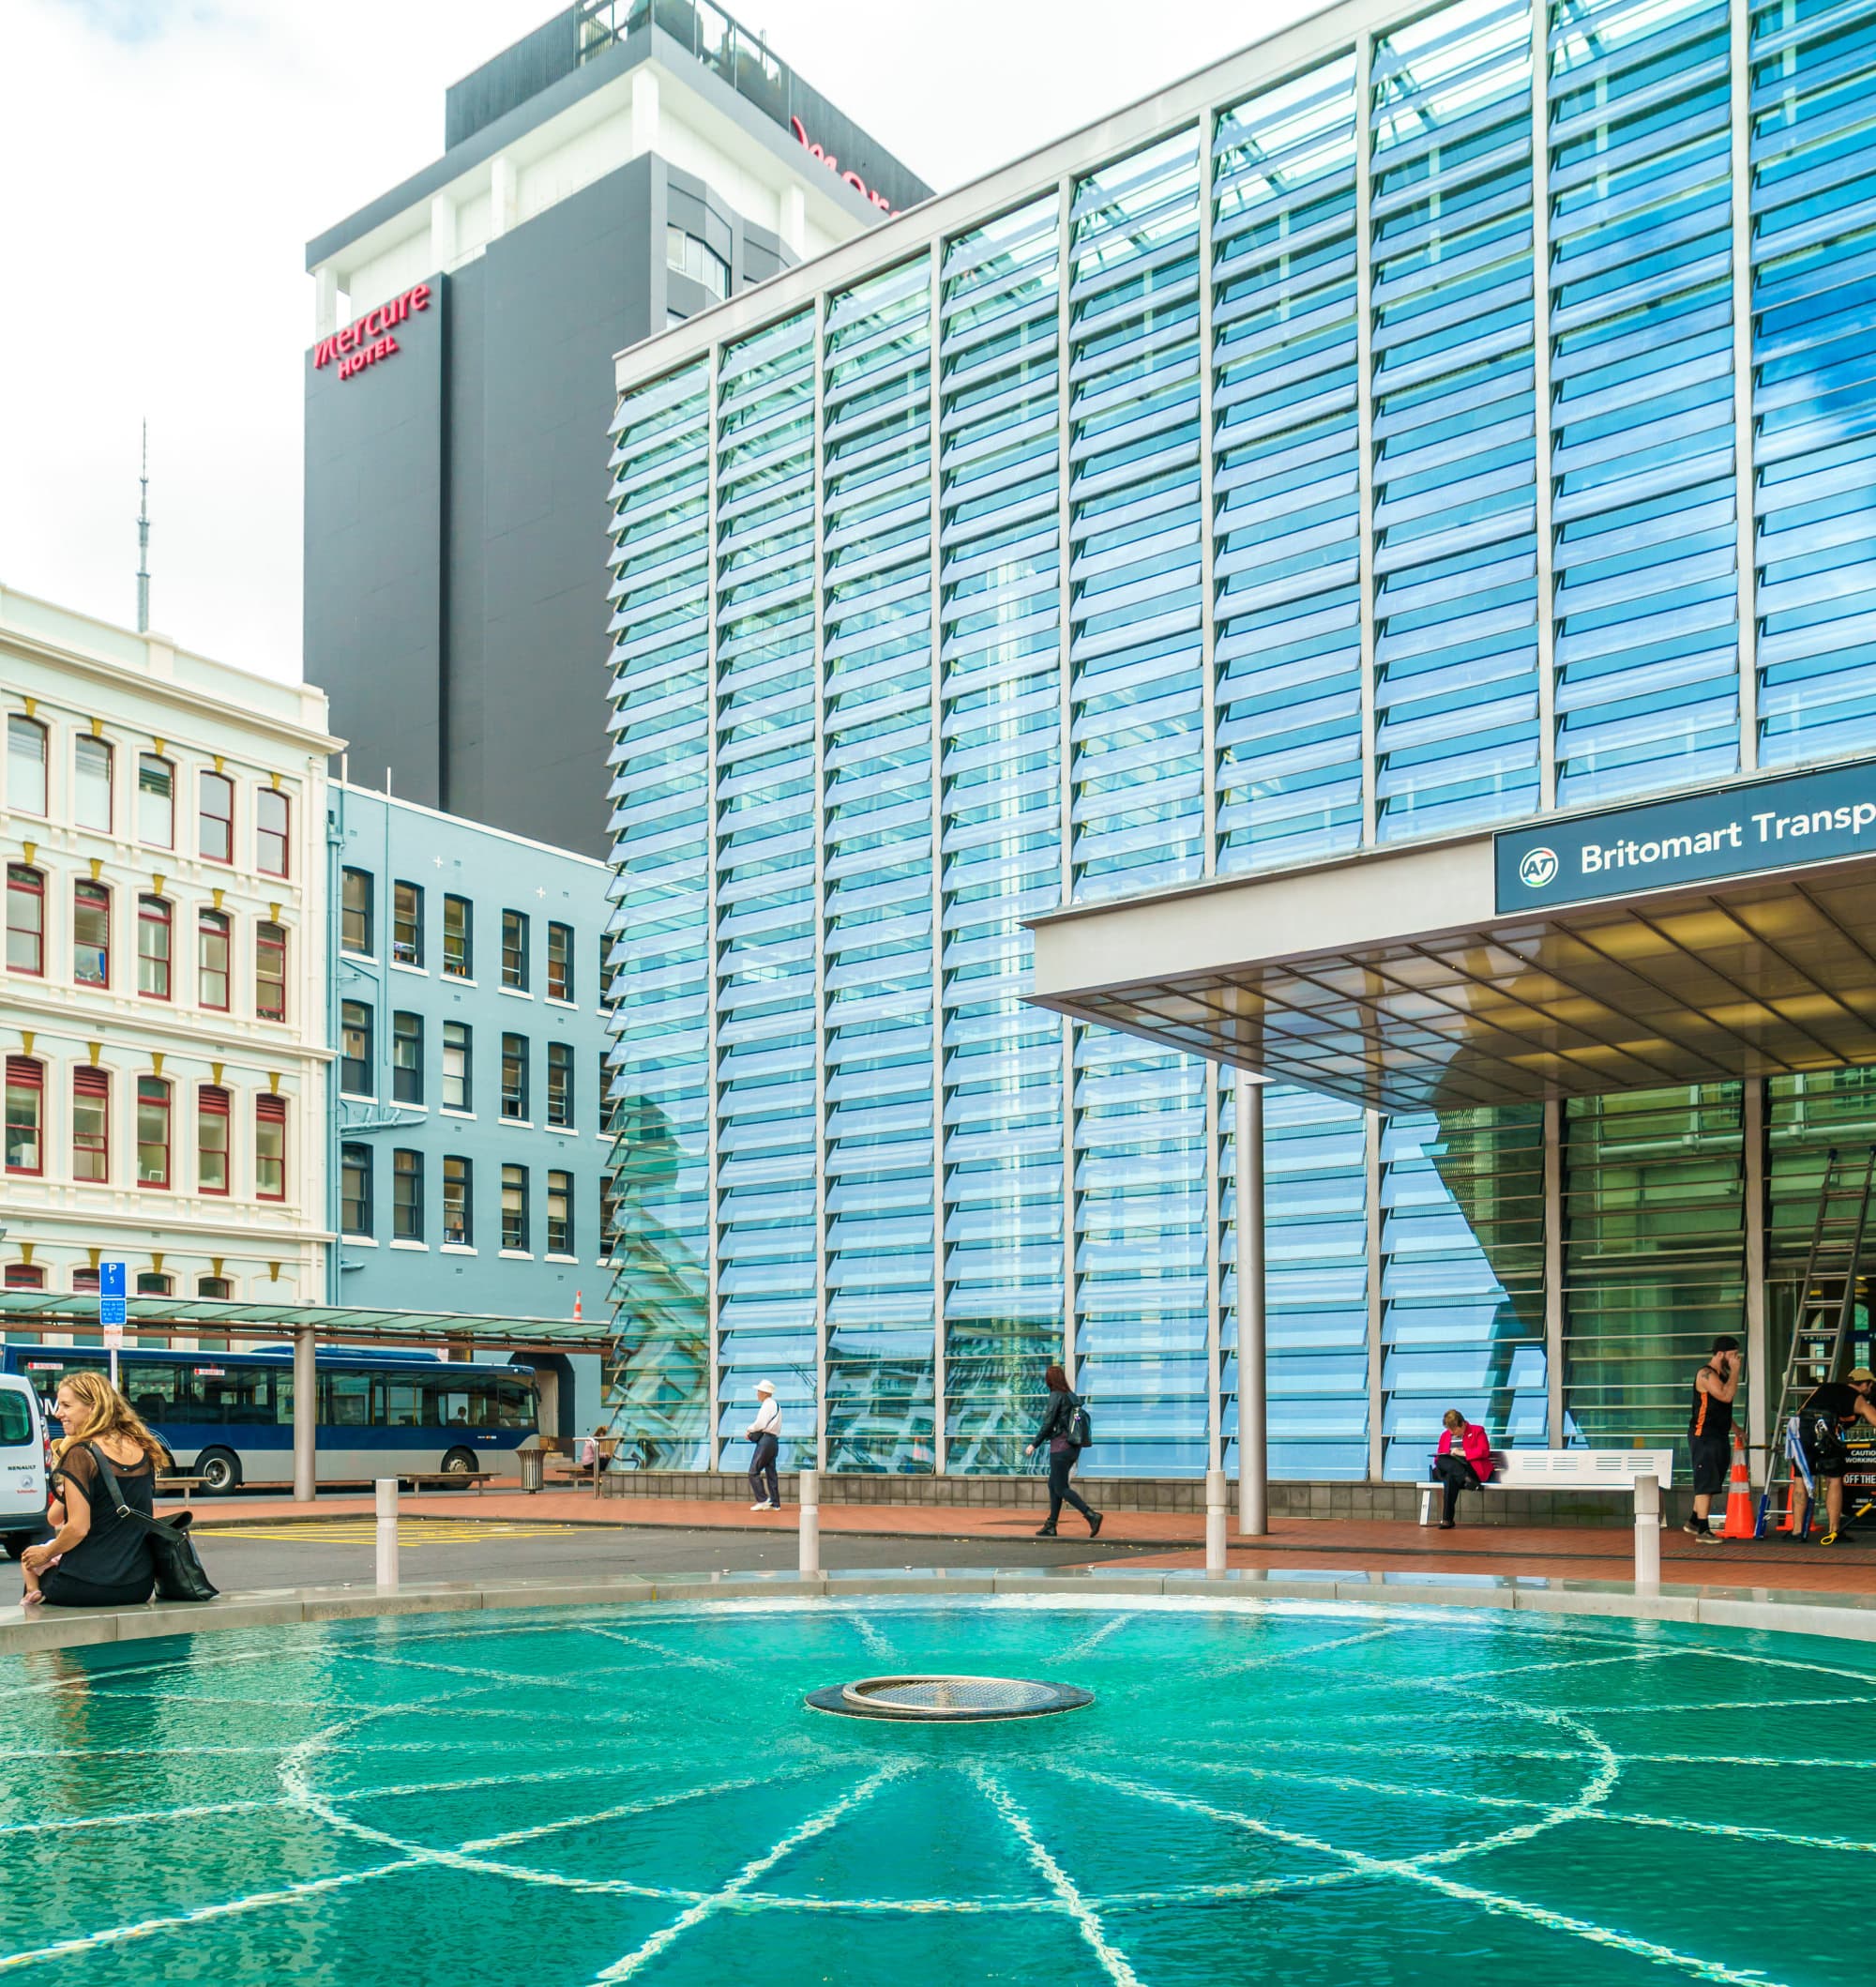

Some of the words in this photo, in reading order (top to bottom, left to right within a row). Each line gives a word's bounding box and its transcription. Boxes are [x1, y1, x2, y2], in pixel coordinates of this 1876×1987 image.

[339, 335, 400, 381] HOTEL
[1581, 822, 1743, 873] Britomart
[1751, 802, 1876, 842] Transp
[108, 1264, 117, 1274] P
